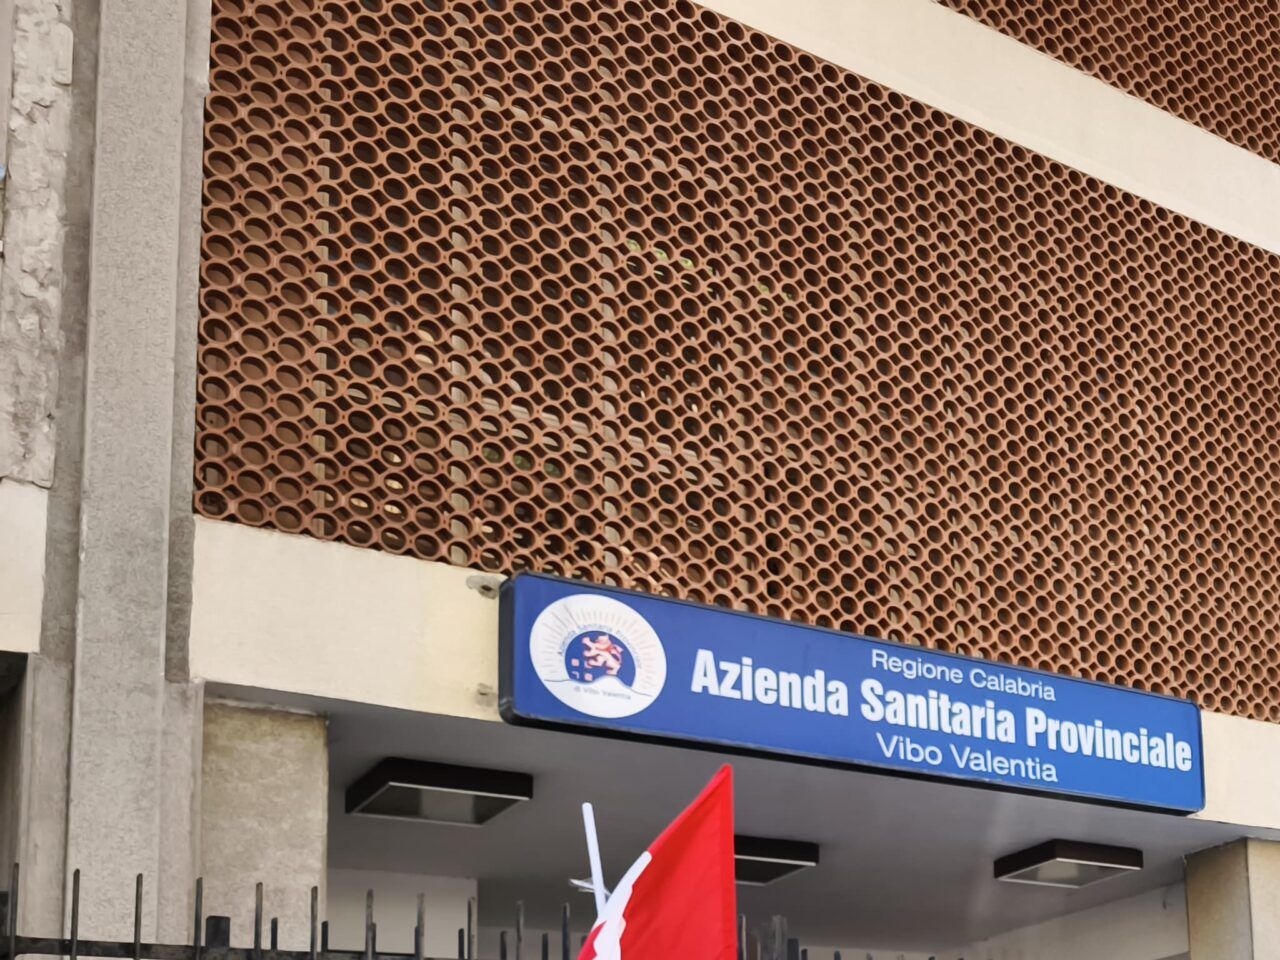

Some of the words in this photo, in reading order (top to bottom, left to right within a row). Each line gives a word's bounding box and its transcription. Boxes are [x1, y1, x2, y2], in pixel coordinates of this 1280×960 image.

[872, 648, 963, 684] Regione
[969, 668, 1056, 701] Calabria
[690, 648, 849, 717] Azienda
[860, 678, 1016, 744] Sanitaria
[1025, 706, 1193, 772] Provinciale
[876, 732, 943, 765] Vibo
[949, 743, 1059, 783] Valentia
